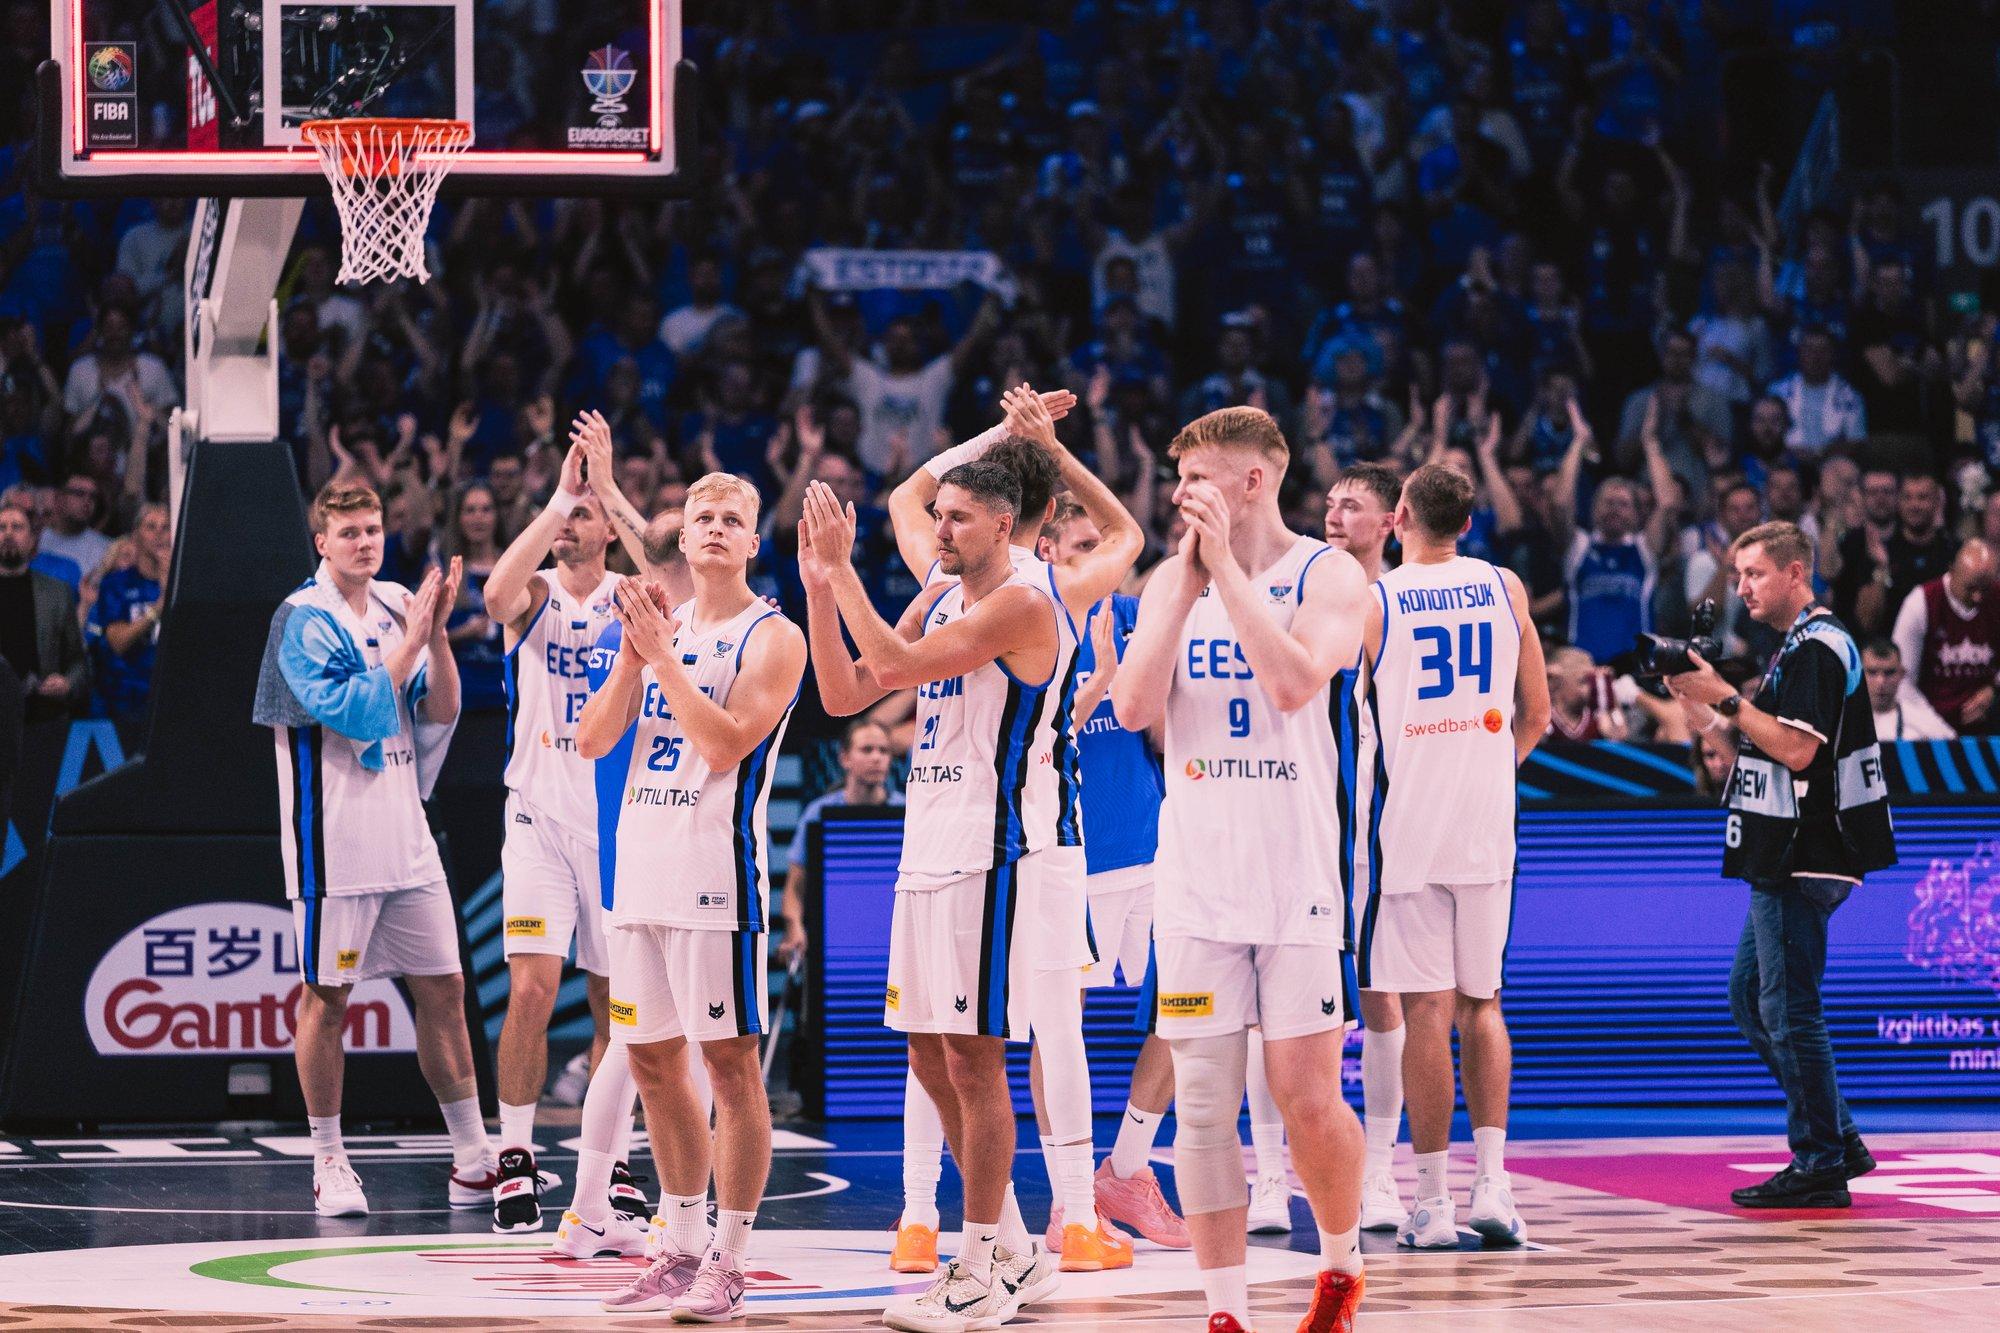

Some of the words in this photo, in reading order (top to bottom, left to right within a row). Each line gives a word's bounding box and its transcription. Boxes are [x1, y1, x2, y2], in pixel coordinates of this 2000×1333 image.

[93, 102, 129, 120] FIBA
[567, 127, 649, 142] EUROBASKET
[1413, 622, 1492, 700] 34
[1229, 698, 1251, 738] 9
[1405, 716, 1480, 738] Swedbank
[647, 736, 684, 772] 25
[1209, 759, 1298, 781] UTILITAS
